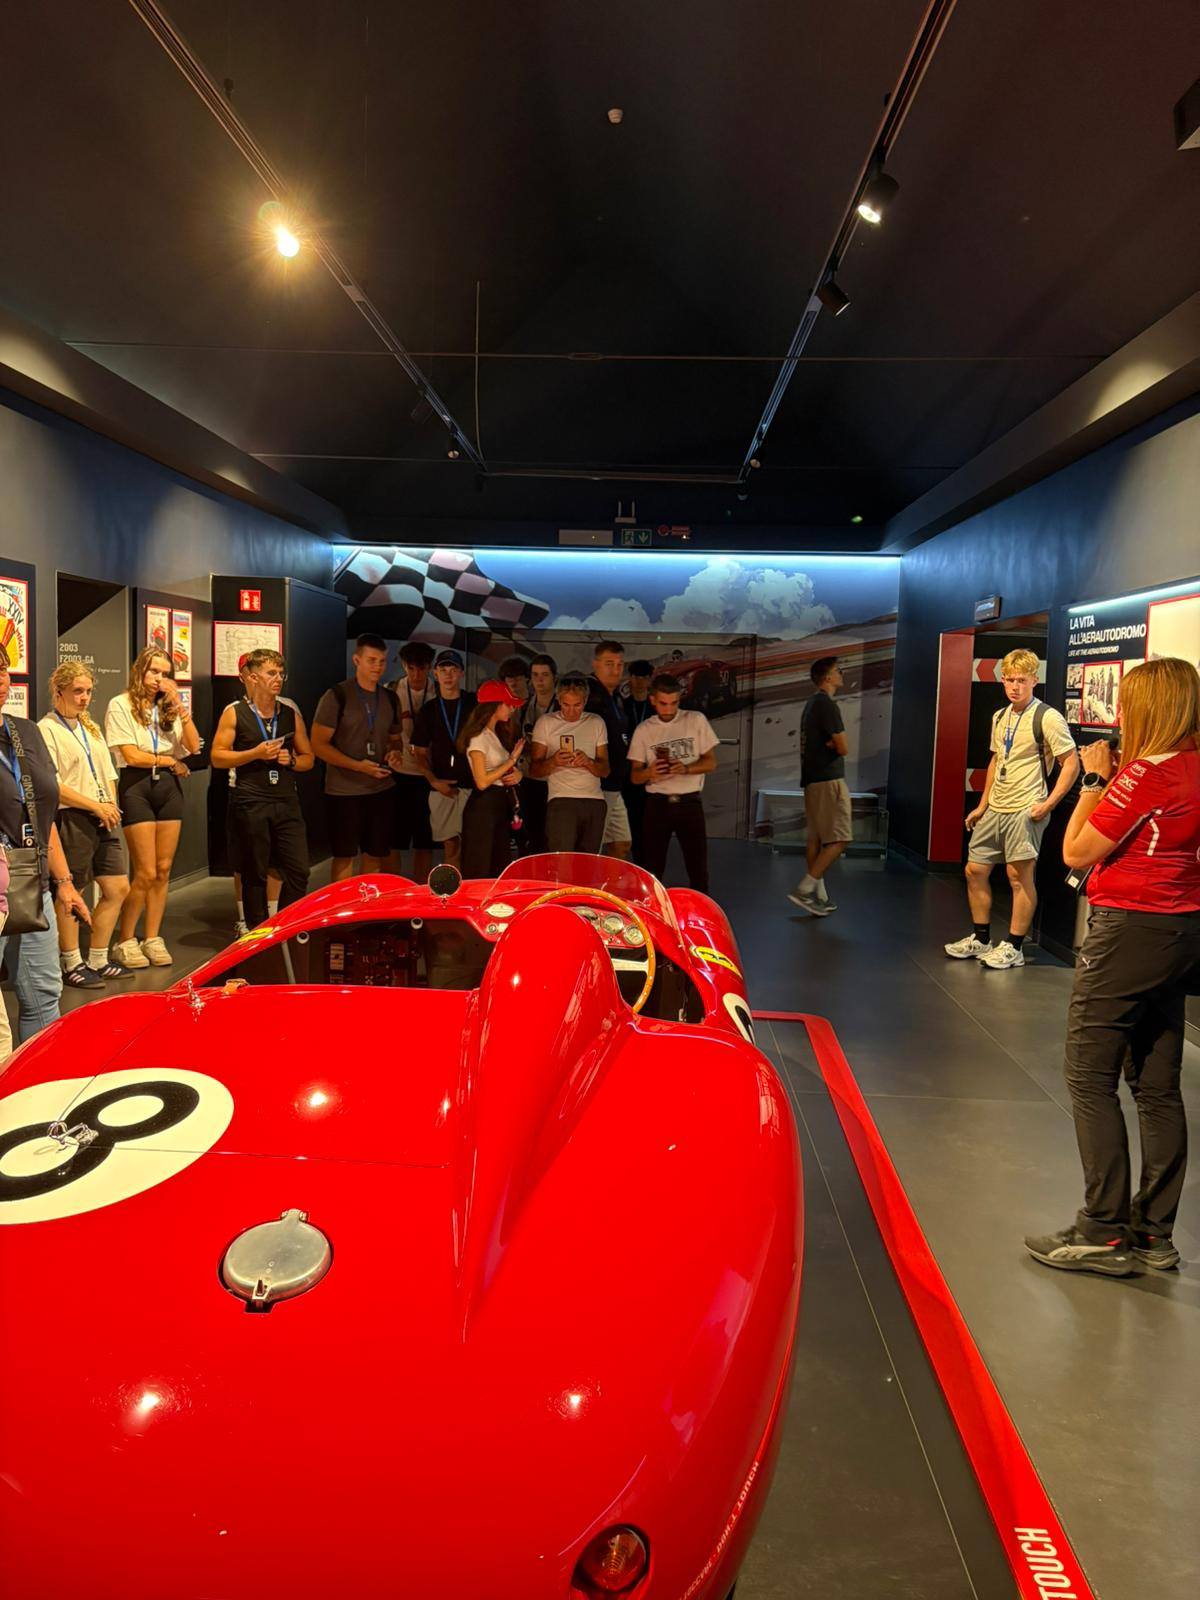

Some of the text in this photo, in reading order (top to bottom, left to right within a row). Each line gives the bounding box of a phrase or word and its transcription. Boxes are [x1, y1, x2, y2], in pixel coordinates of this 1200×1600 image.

[1069, 614, 1095, 630] LA VITA
[1069, 623, 1147, 646] ALL'AERAUTODROMO
[59, 643, 79, 652] 2003
[22, 774, 35, 801] GINO
[0, 1080, 200, 1201] 8
[1014, 1527, 1078, 1600] TOUCH
